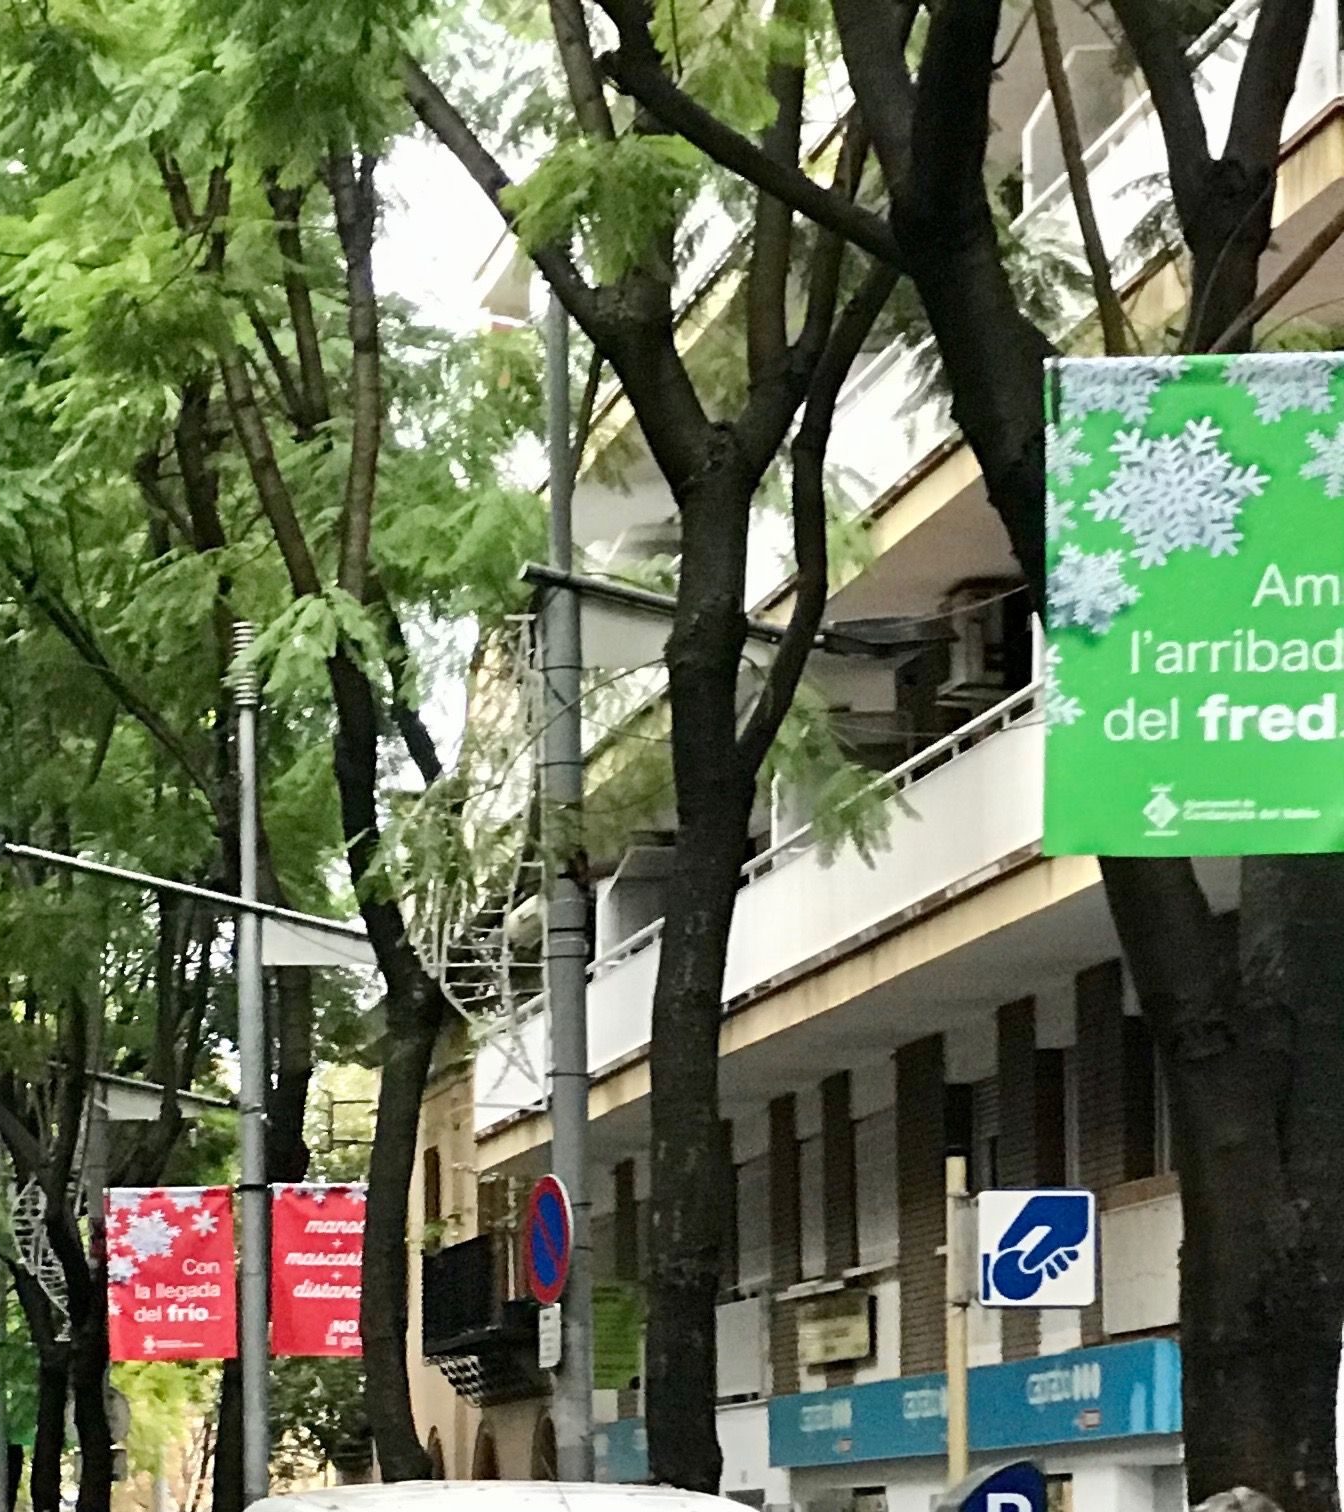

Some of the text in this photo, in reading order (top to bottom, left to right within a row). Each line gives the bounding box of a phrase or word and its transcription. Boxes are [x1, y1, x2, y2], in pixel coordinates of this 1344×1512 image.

[1251, 563, 1342, 607] Am
[1130, 627, 1344, 675] l'arribad
[1103, 697, 1179, 741] del
[182, 1258, 220, 1275] Con
[134, 1282, 221, 1302] la llegada
[292, 1279, 363, 1299] distanc
[133, 1306, 163, 1323] del
